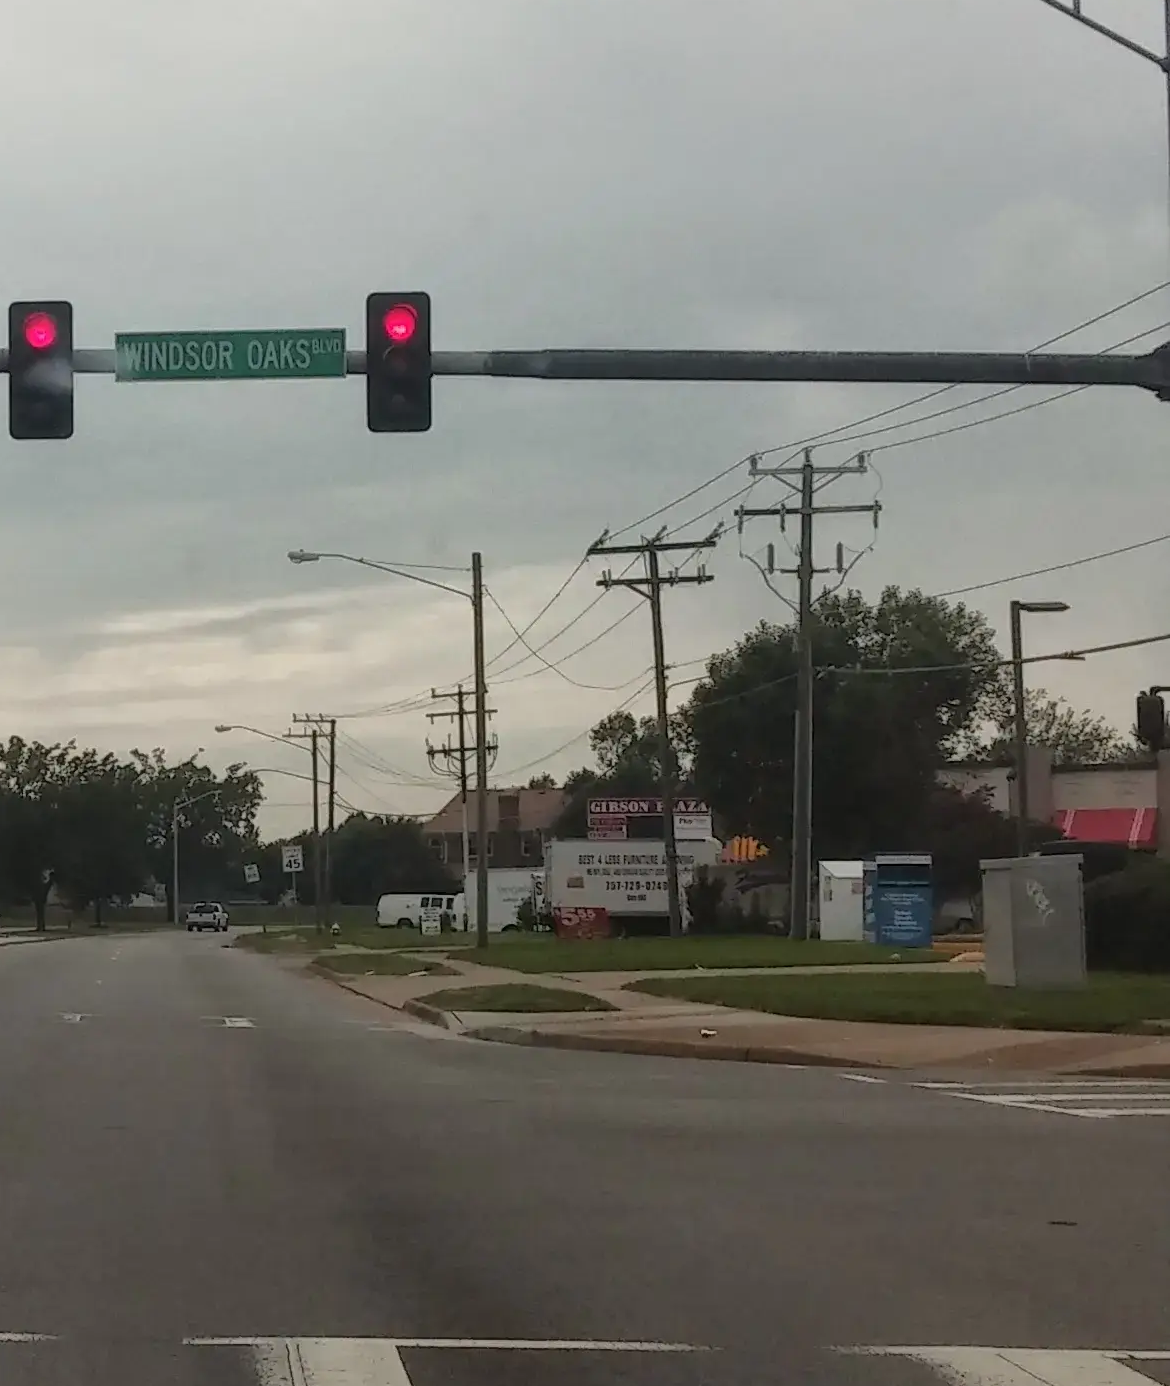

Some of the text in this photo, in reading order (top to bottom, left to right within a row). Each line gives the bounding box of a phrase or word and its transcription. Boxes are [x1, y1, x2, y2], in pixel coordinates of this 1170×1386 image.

[123, 339, 342, 372] WINDSOR OAKS BLVD
[590, 800, 650, 813] GIBSON
[285, 859, 301, 869] 45
